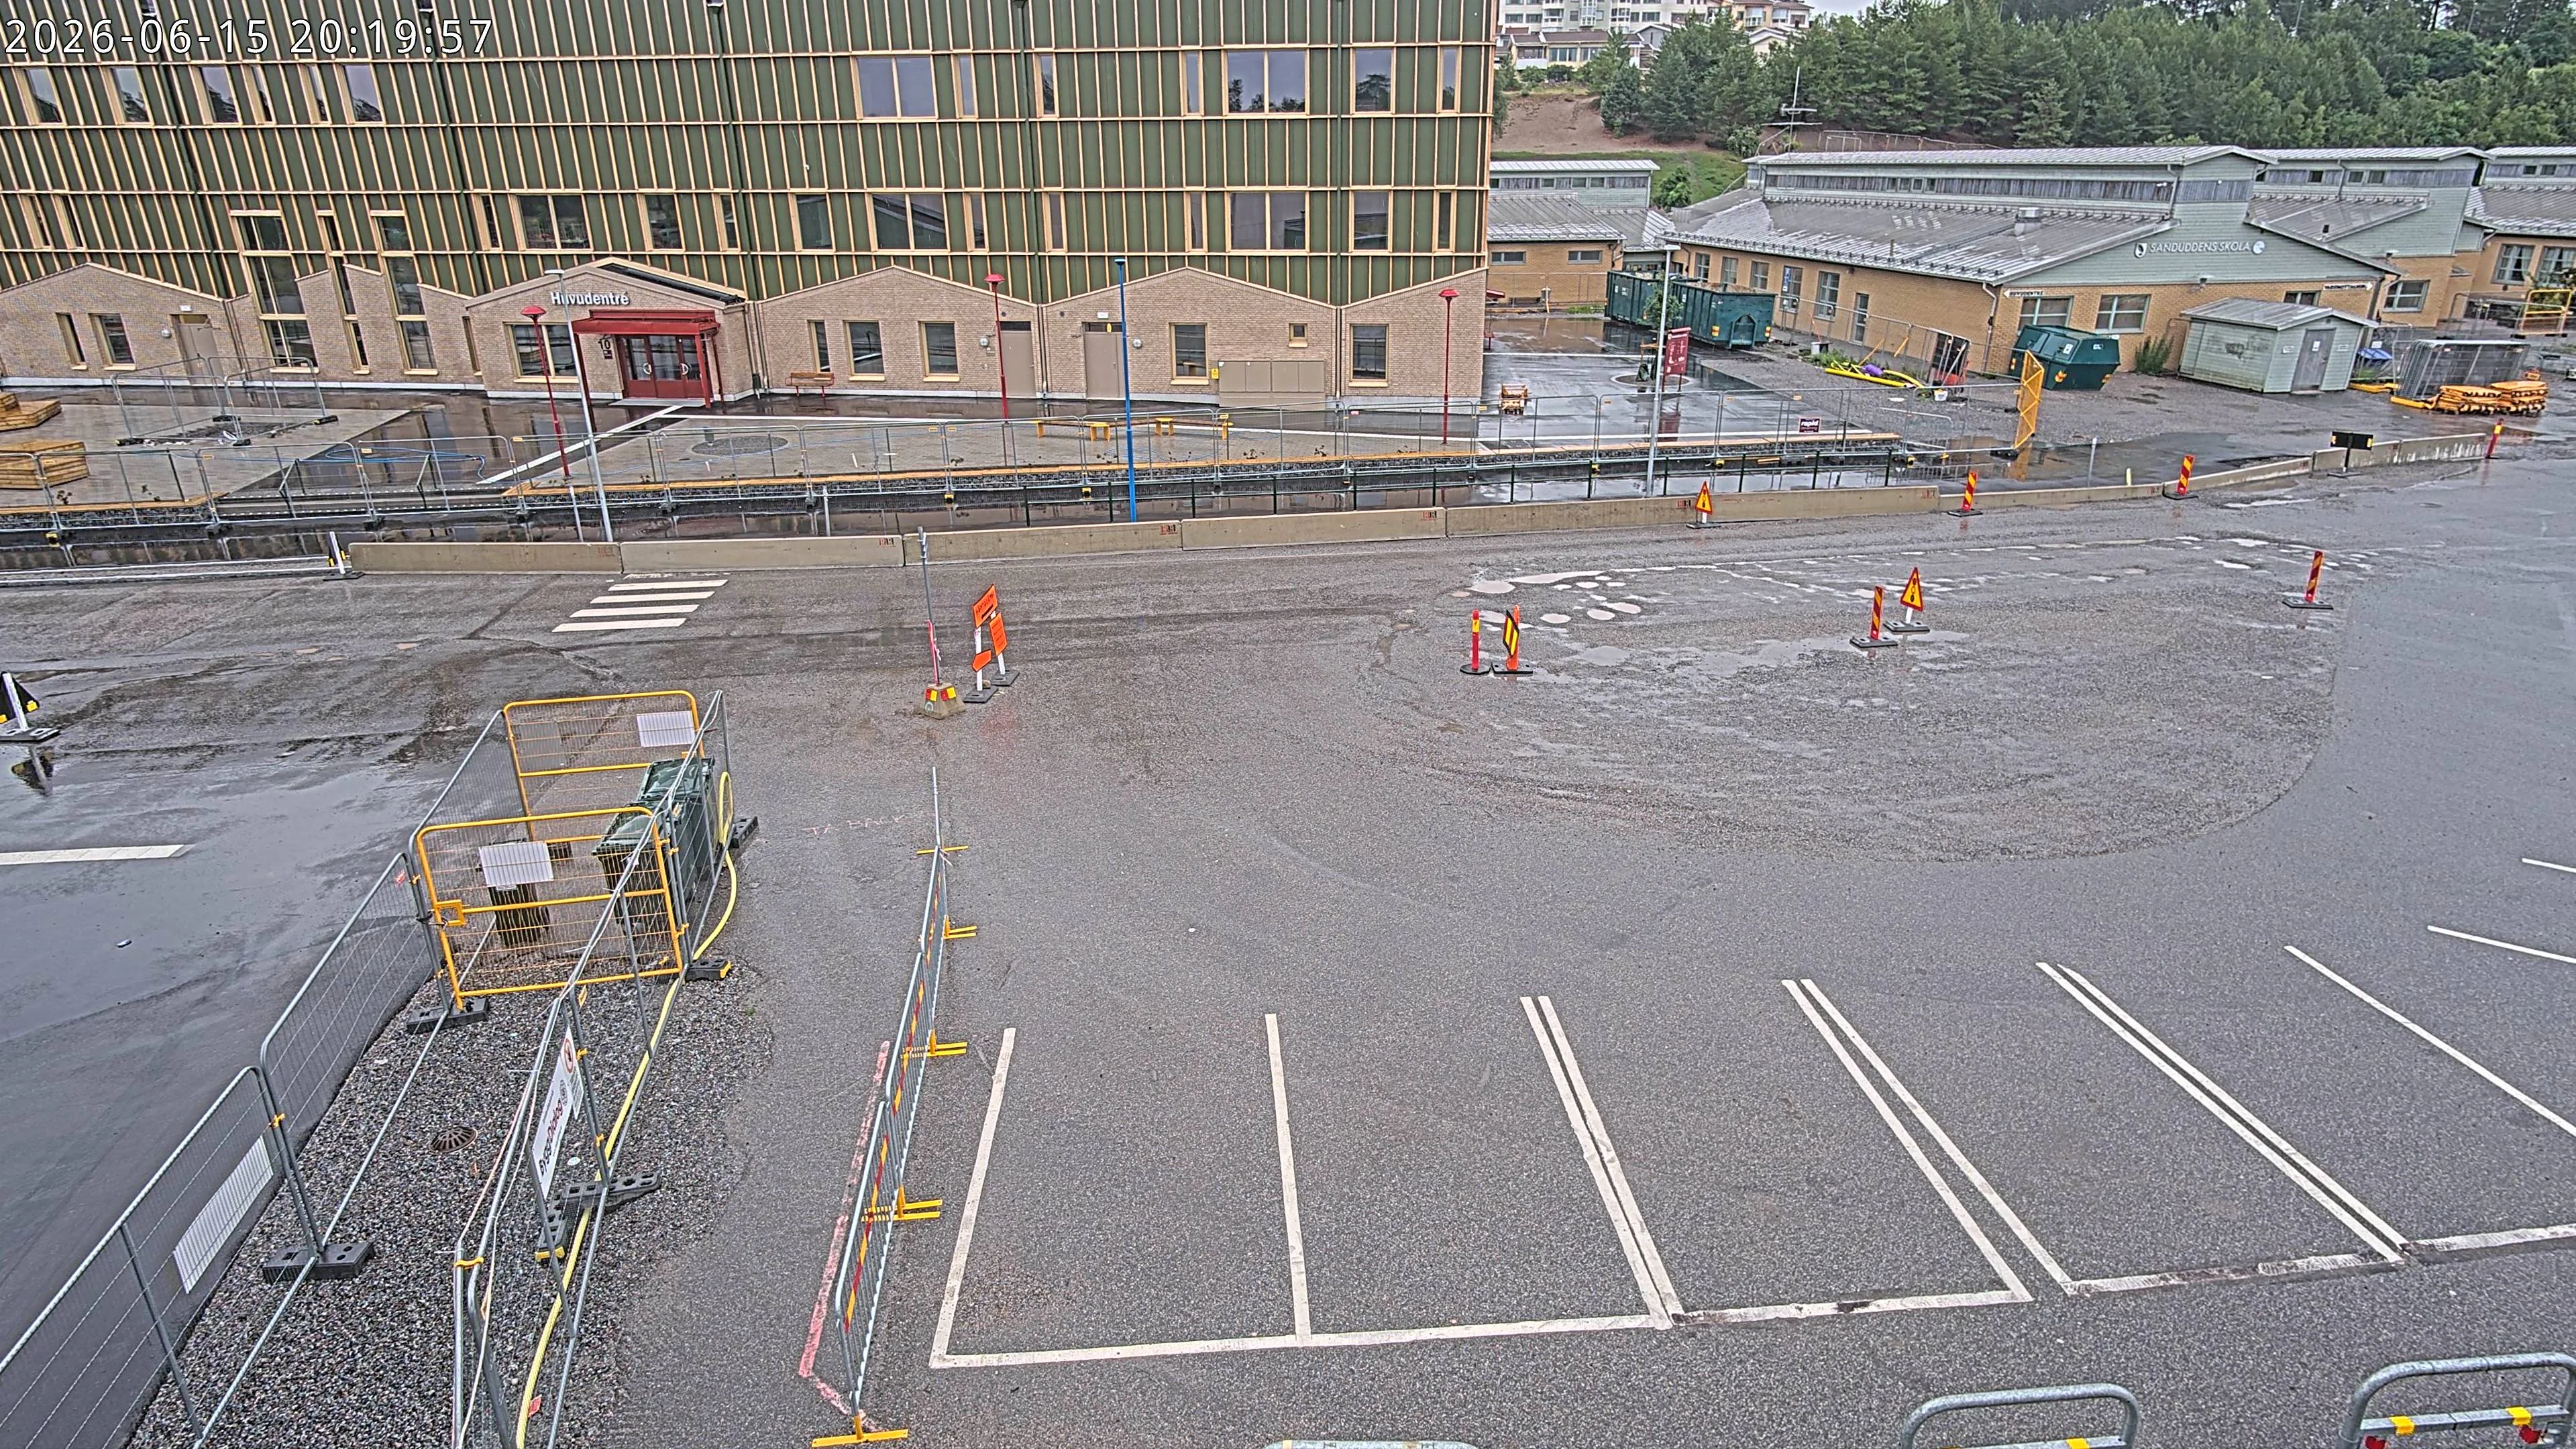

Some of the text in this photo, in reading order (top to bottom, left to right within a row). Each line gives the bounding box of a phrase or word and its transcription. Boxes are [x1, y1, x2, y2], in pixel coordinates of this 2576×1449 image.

[2149, 241, 2250, 253] SANDUDDENS SKOLA
[550, 291, 629, 305] Huvudentré
[598, 339, 611, 350] 10
